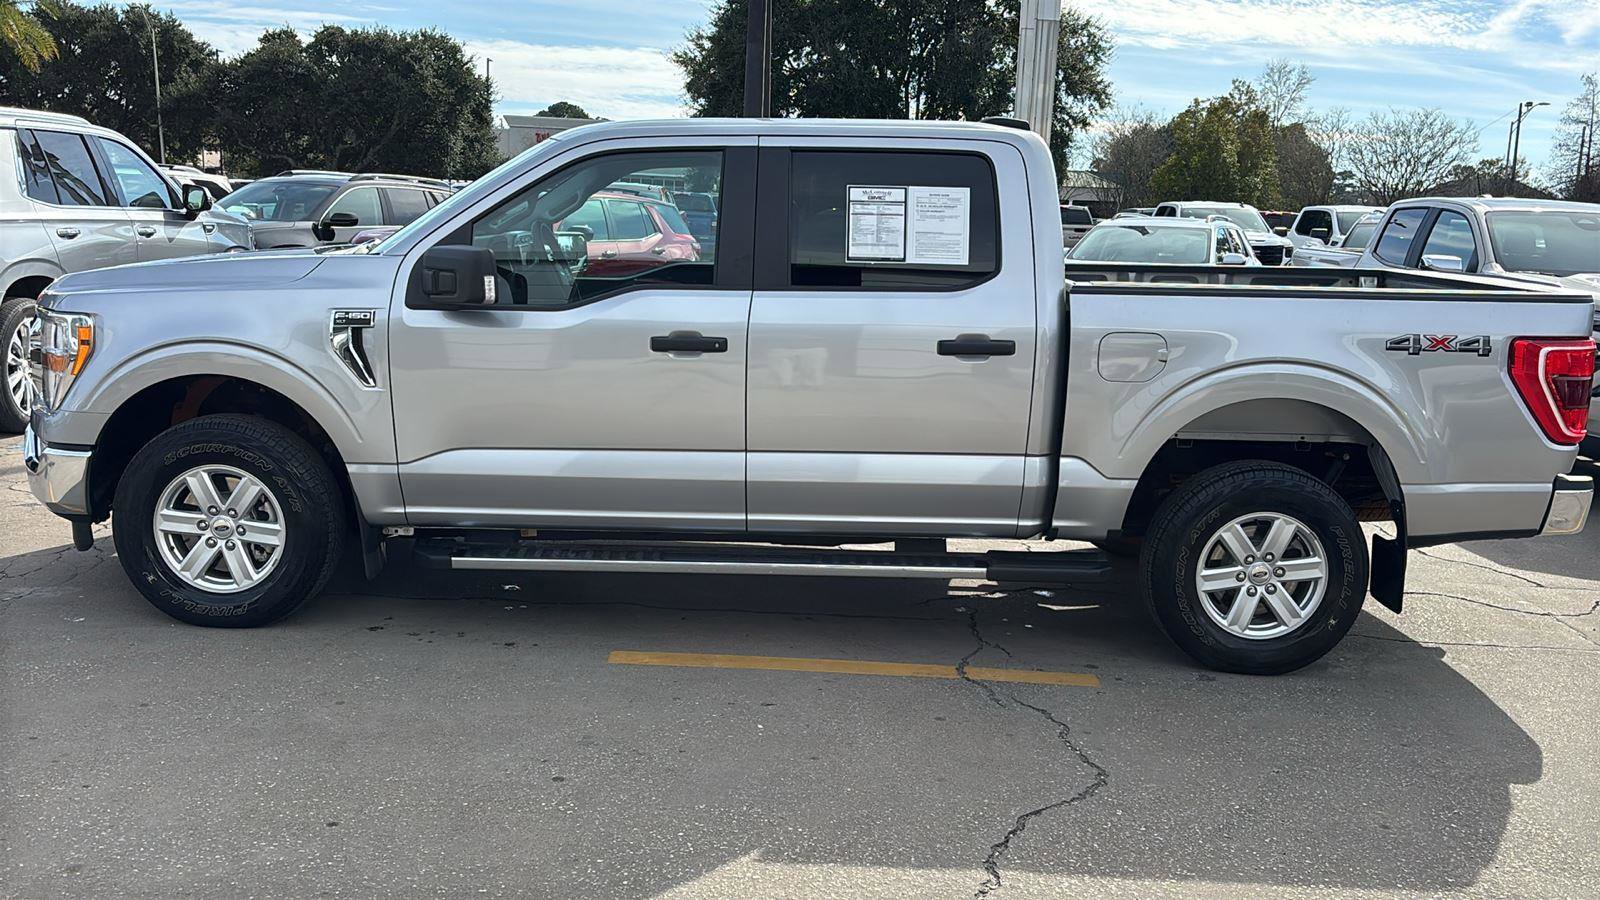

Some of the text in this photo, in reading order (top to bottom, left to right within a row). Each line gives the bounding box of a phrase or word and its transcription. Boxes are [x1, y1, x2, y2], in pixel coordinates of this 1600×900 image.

[162, 442, 273, 472] SCORPION
[1329, 525, 1355, 609] PIRELLI
[159, 588, 249, 616] PIRELLI
[1174, 545, 1217, 648] SCORPION
